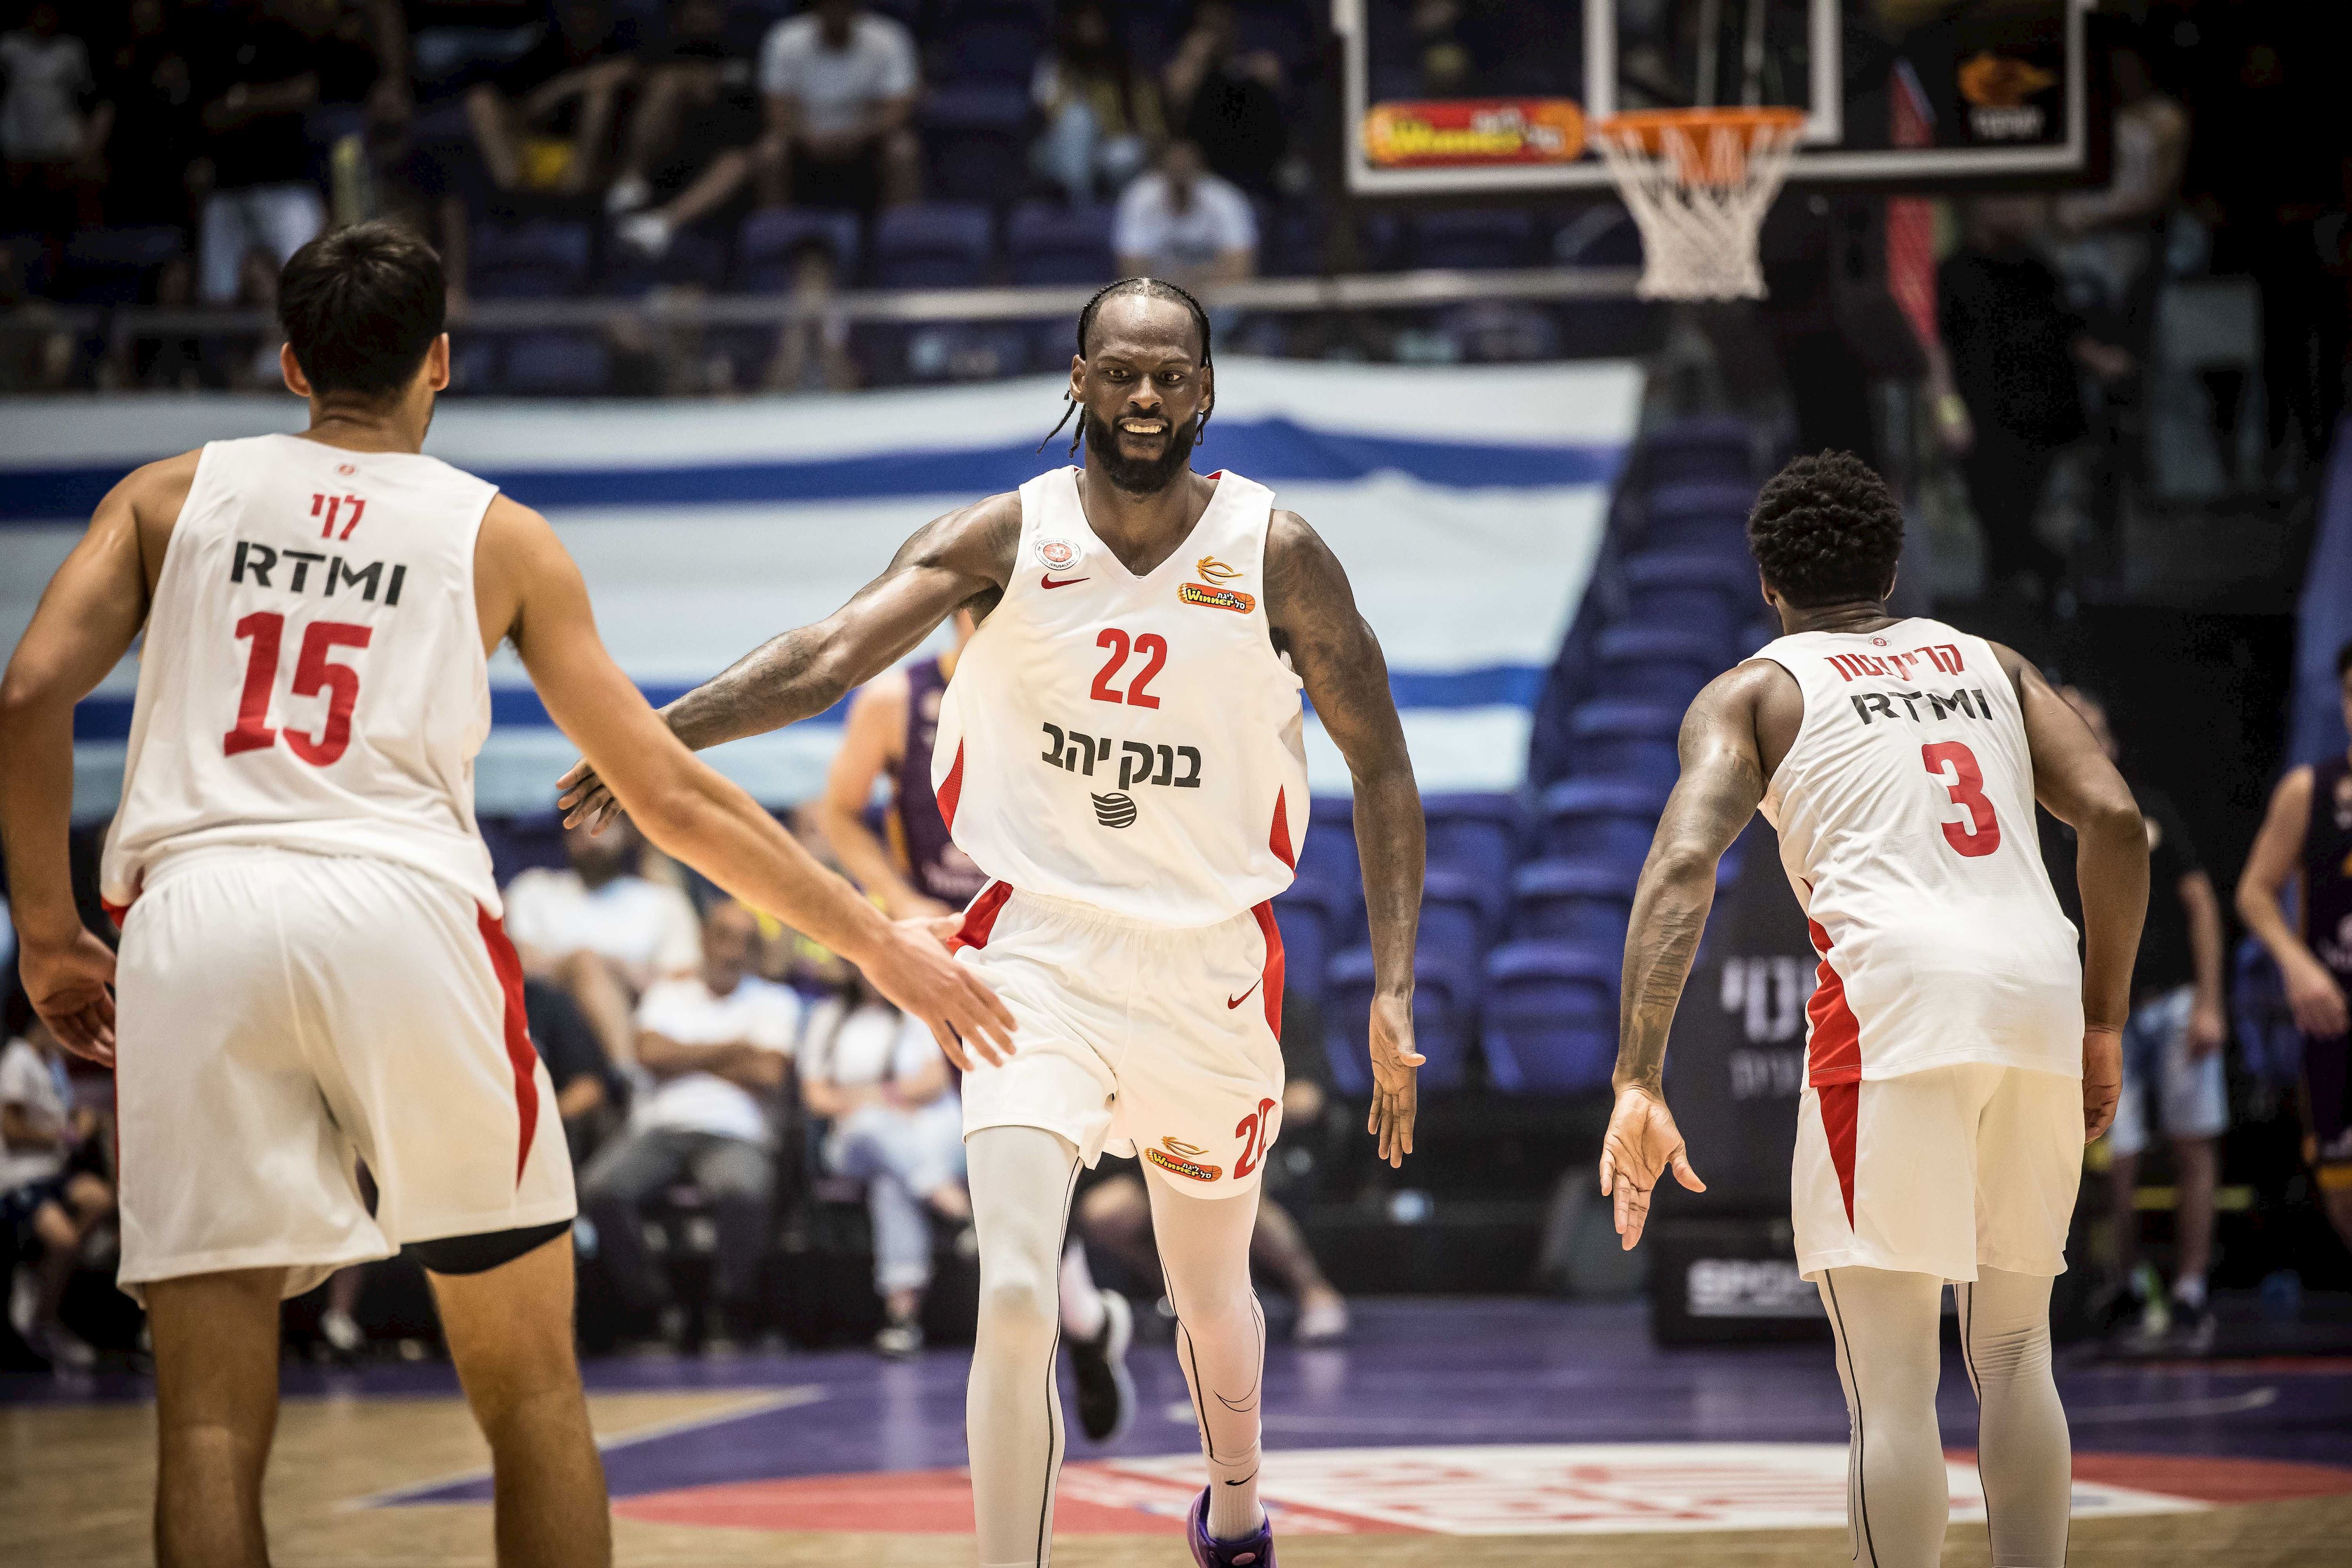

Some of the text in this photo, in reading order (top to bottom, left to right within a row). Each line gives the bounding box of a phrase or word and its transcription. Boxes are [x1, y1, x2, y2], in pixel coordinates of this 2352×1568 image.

[310, 493, 366, 541] לוי
[231, 541, 407, 606] RTMI
[1186, 588, 1234, 606] Winner
[1234, 599, 1246, 610] סל
[222, 611, 373, 768] 15
[1090, 628, 1168, 710] 22
[1851, 689, 1993, 725] RTMI
[1042, 722, 1201, 791] בנק יהב
[1922, 741, 2001, 857] 3
[1152, 1152, 1200, 1177] Winner
[1182, 1162, 1200, 1171] ליגת
